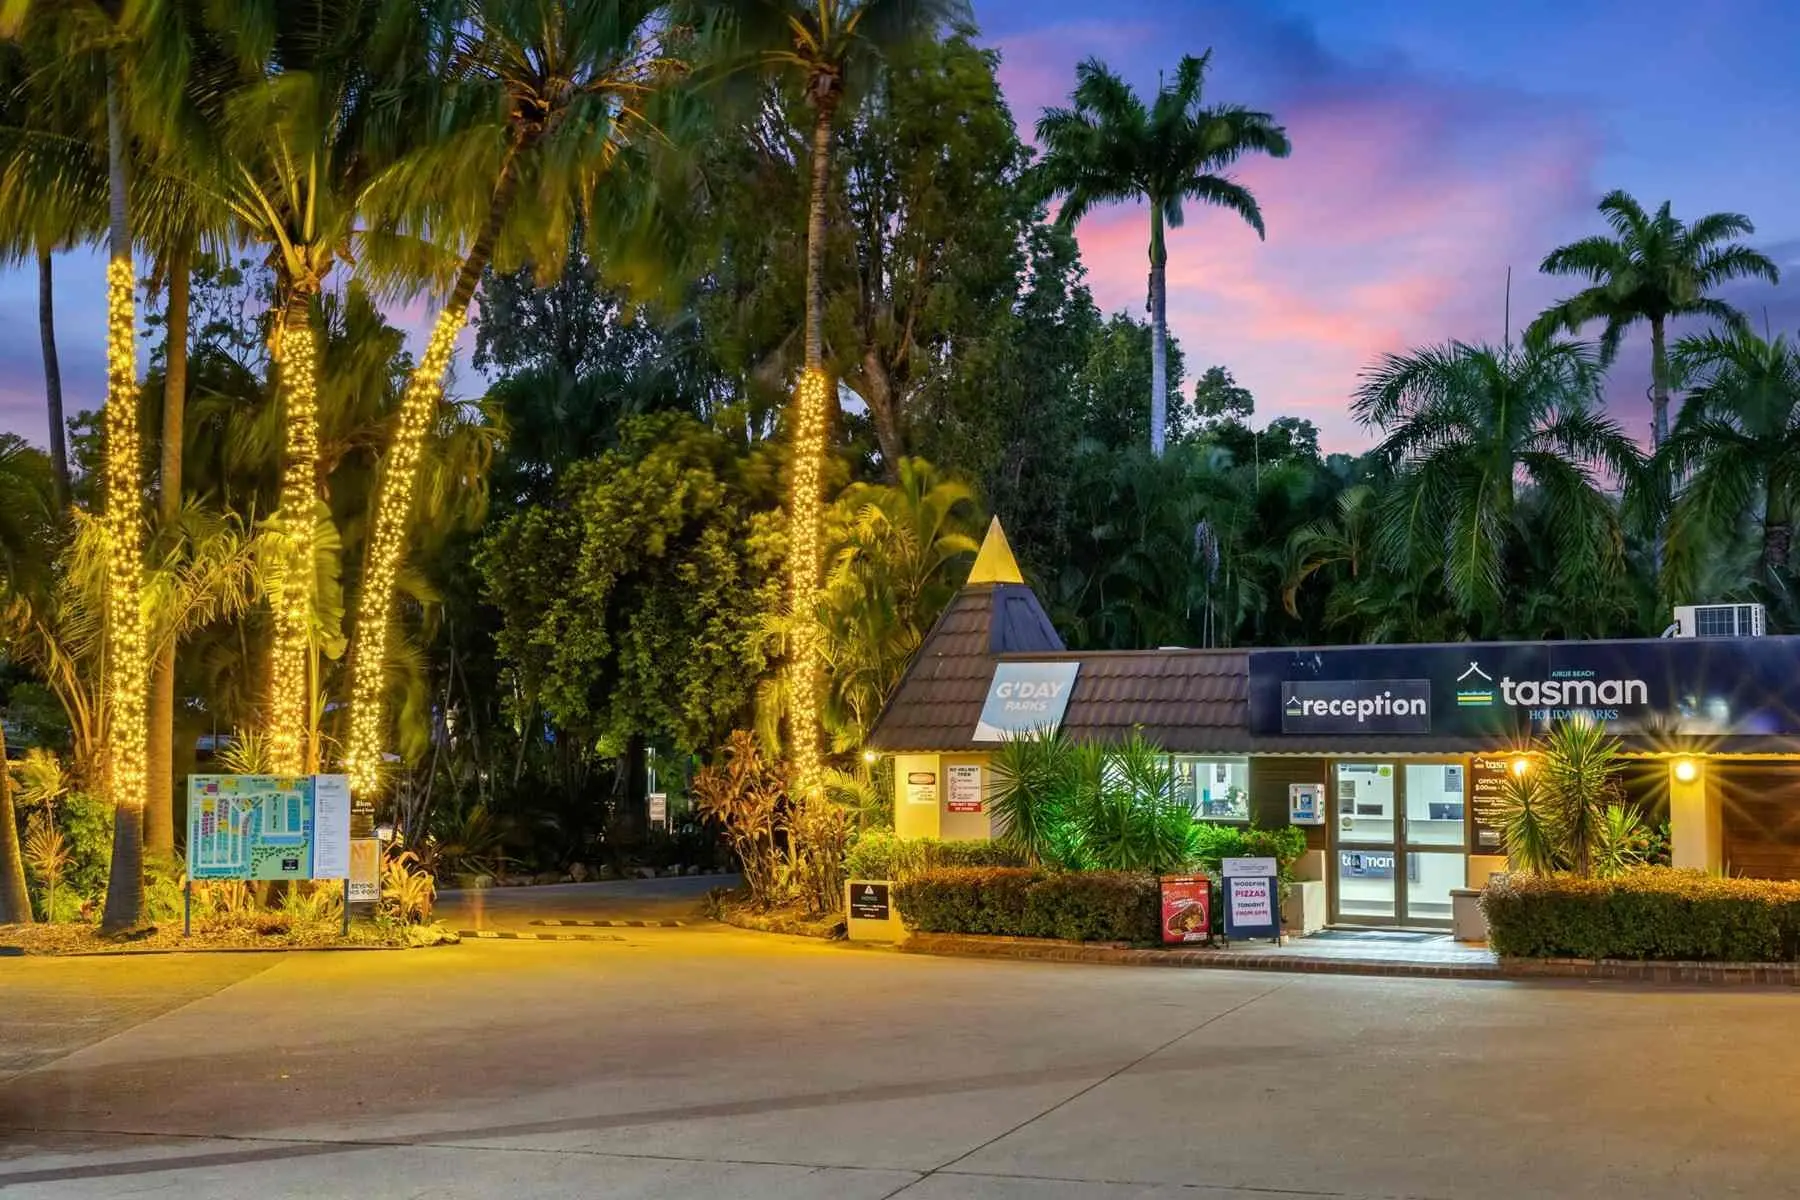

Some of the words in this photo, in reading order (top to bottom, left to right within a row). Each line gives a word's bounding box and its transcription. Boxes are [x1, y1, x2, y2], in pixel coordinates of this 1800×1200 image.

[997, 682, 1062, 698] G'DAY
[1500, 676, 1647, 705] tasman
[1303, 691, 1426, 722] reception
[1235, 889, 1266, 897] PIZZAS
